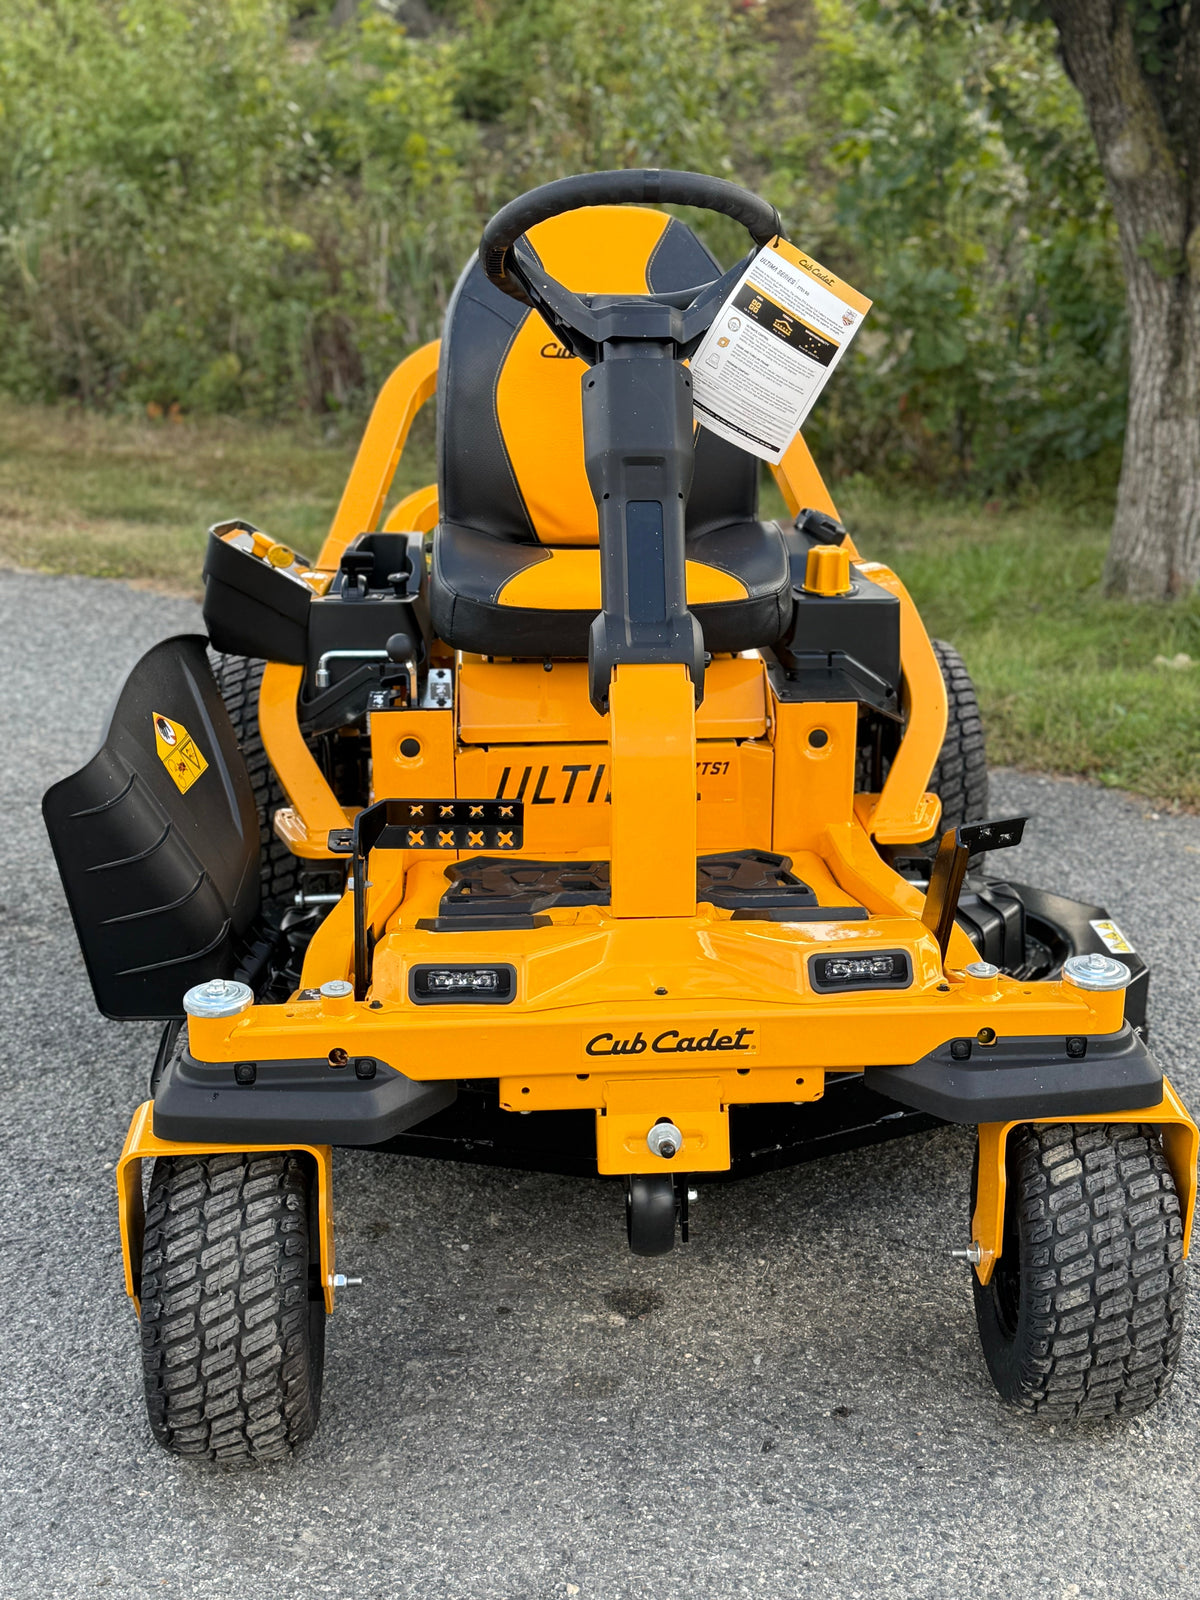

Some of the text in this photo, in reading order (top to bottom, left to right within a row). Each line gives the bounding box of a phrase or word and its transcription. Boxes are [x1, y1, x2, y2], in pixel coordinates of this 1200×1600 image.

[759, 257, 778, 272] ULTIMA
[777, 269, 797, 285] SERIES
[798, 259, 835, 287] Cub Cadet
[495, 764, 613, 805] ULTI
[585, 1028, 754, 1056] Cub Cadet
